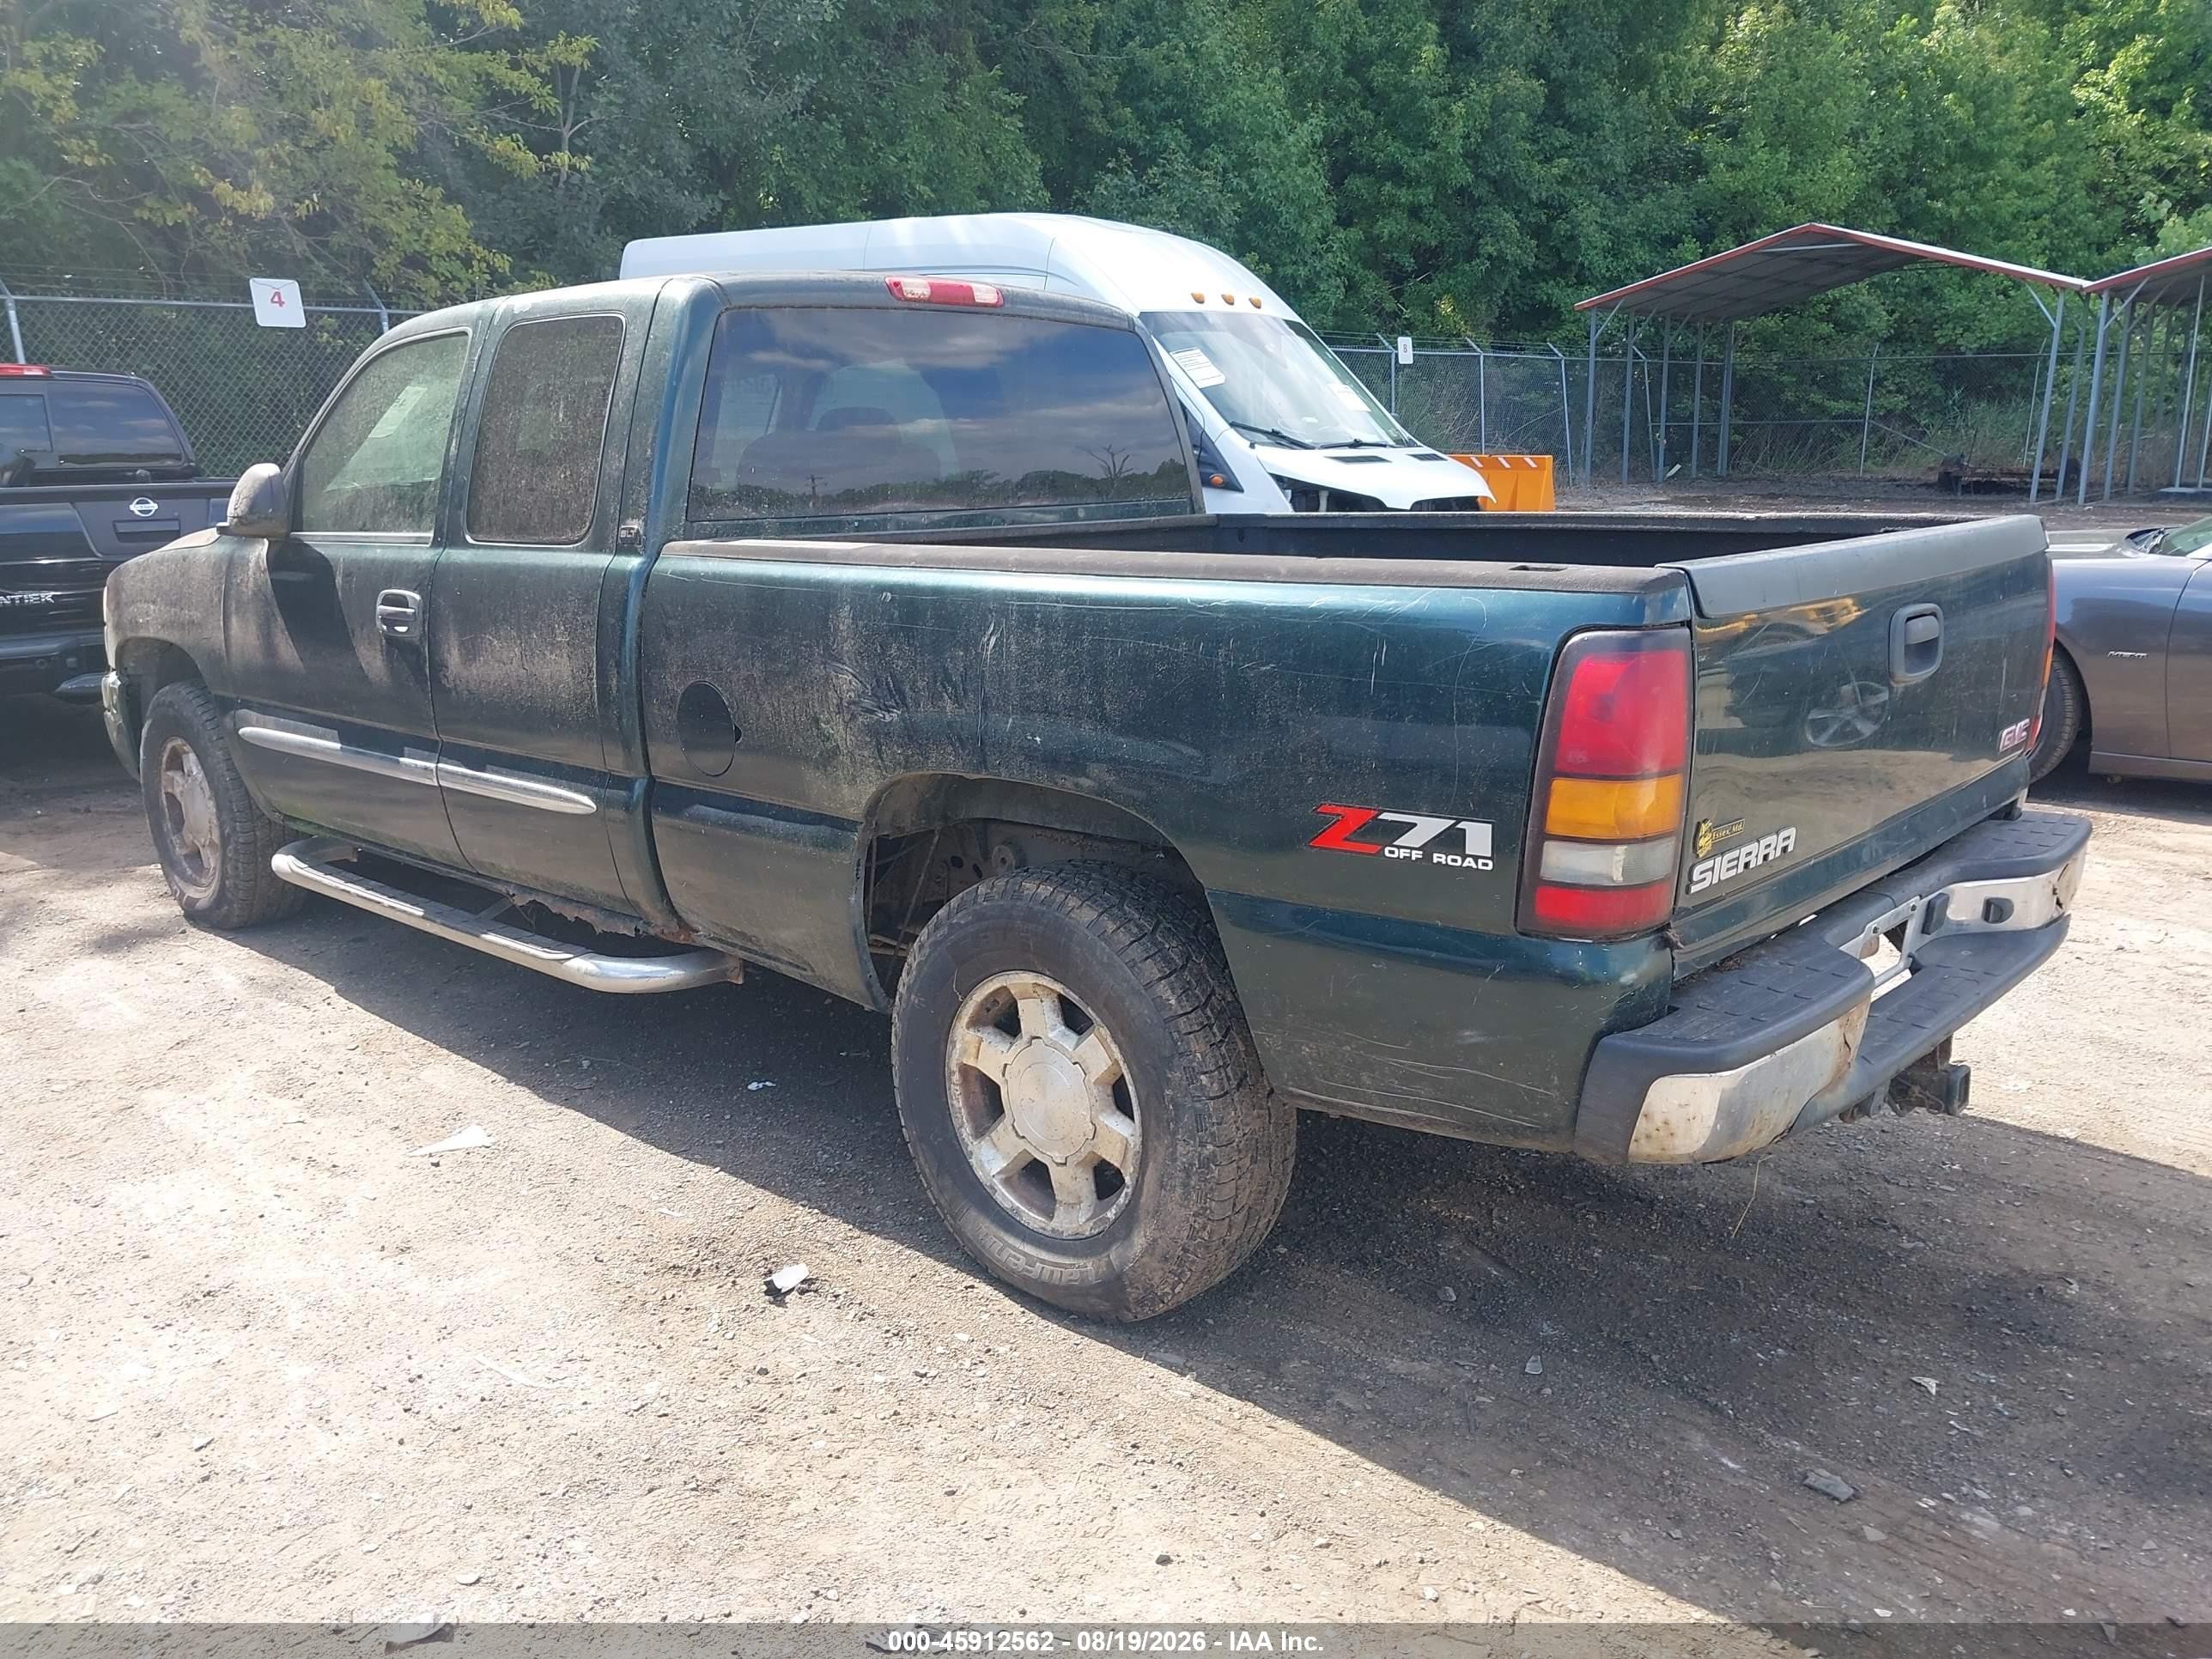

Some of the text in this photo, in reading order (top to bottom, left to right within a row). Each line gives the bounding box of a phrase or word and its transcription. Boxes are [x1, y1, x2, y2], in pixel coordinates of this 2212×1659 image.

[270, 291, 285, 307] 4
[1402, 343, 1408, 353] 8
[1309, 803, 1493, 857] Z71
[1384, 846, 1494, 871] OFF ROAD
[1690, 826, 1796, 894] SIERRA
